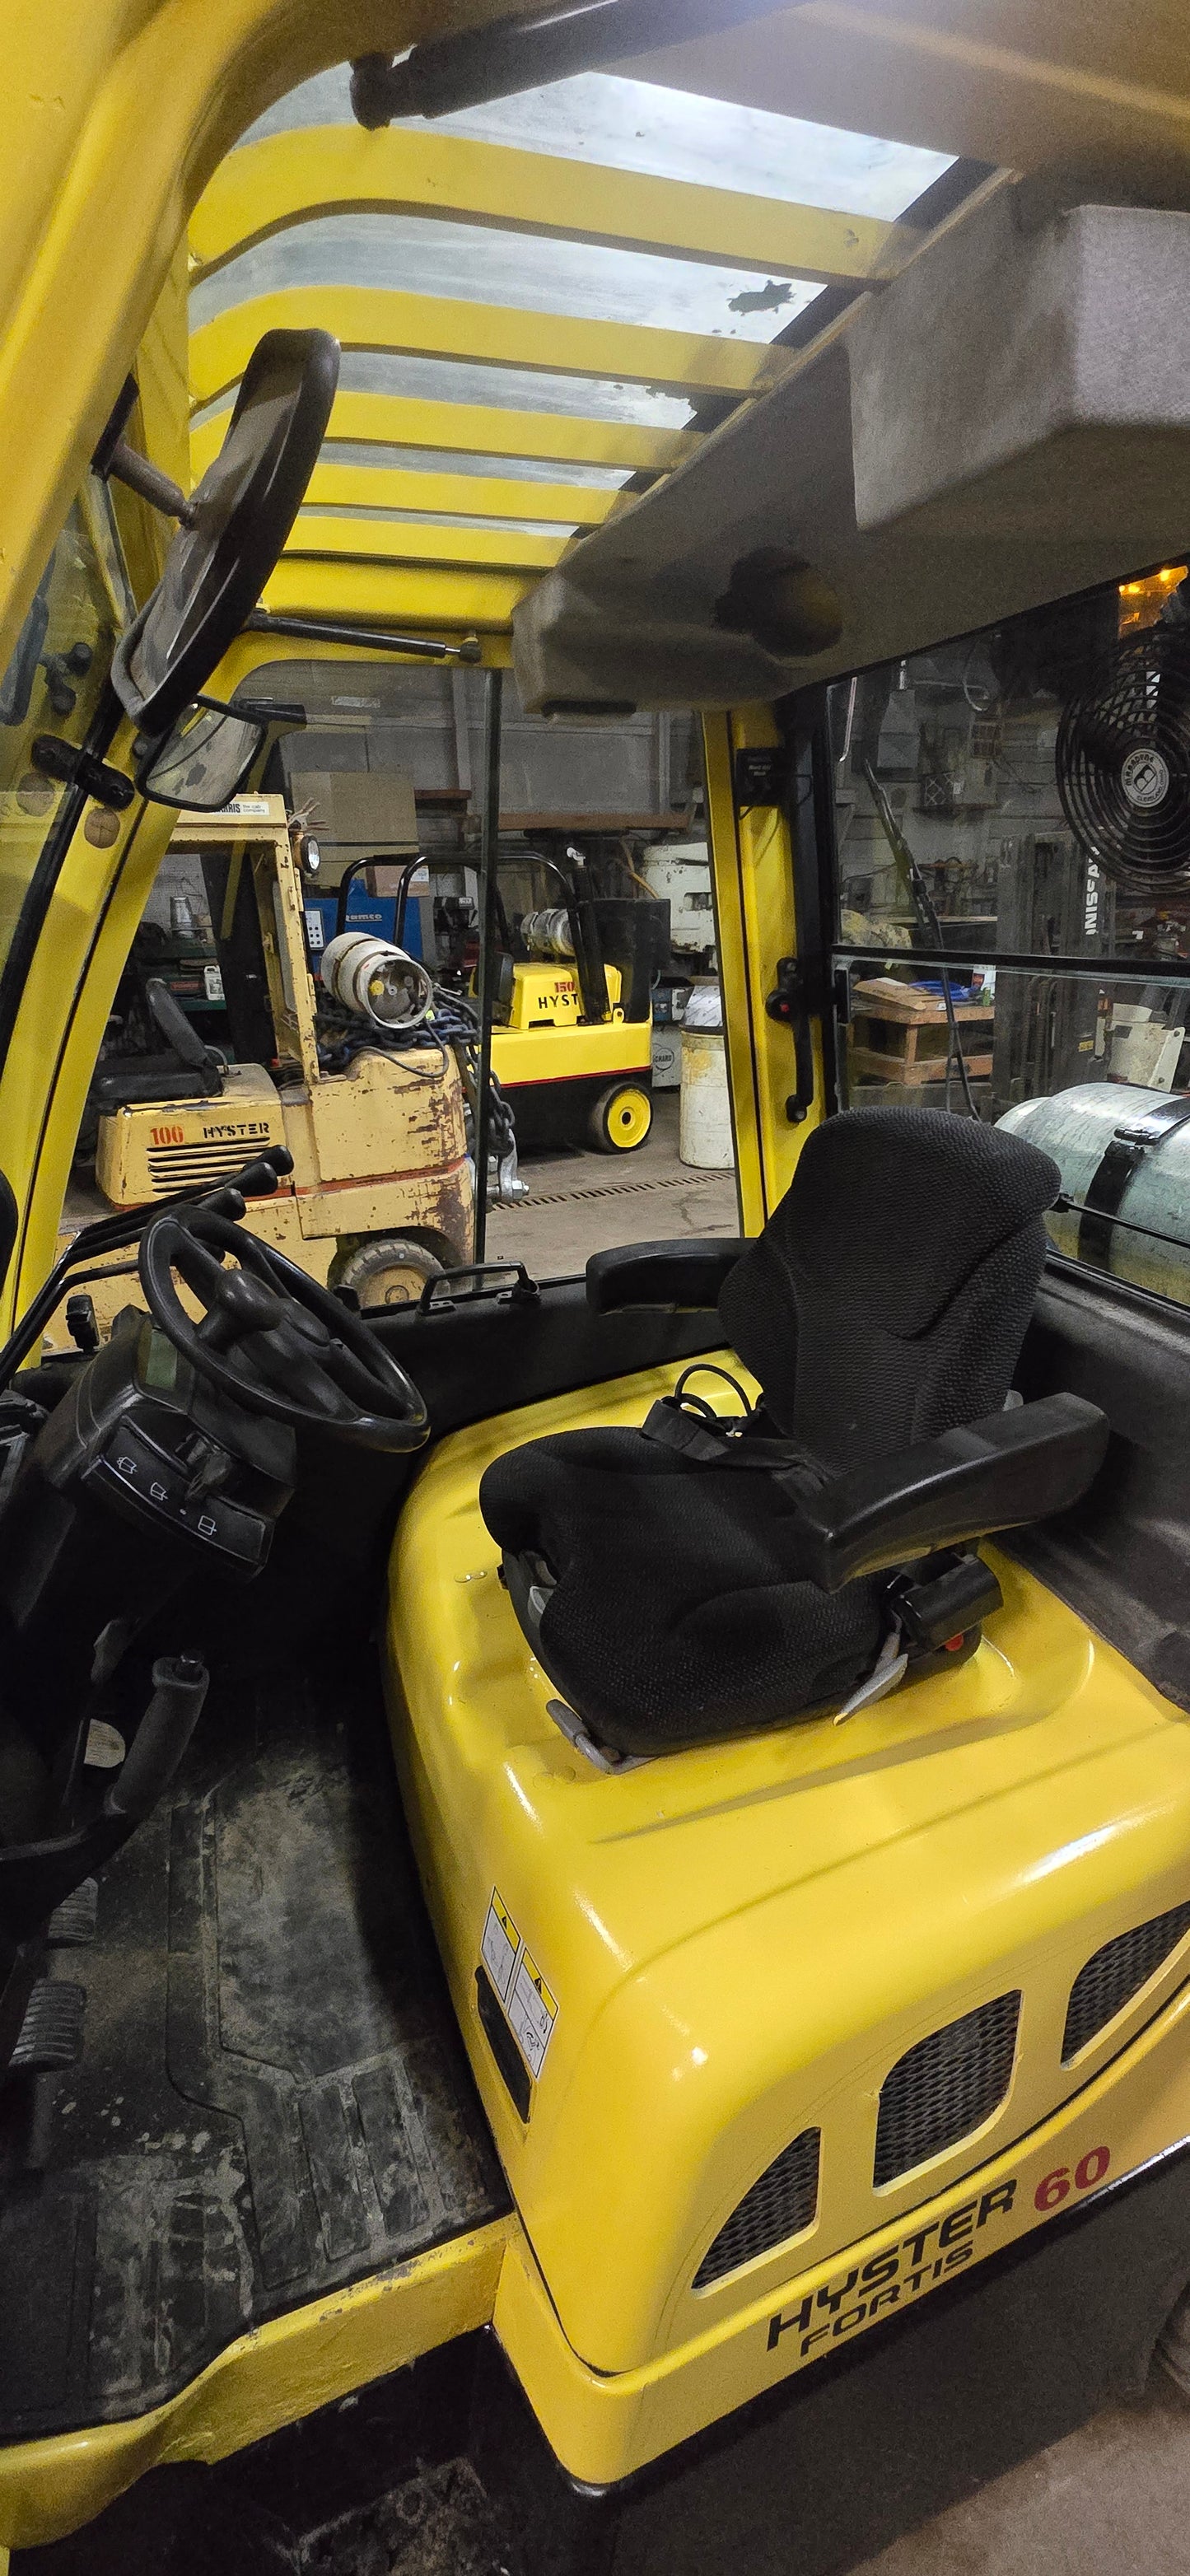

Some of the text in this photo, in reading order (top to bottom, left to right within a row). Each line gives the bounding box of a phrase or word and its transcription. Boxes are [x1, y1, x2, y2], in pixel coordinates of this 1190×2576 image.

[554, 981, 576, 993] 150
[538, 992, 579, 1010] HYST
[150, 1122, 270, 1146] 100 HYSTER
[767, 2145, 1111, 2353] HYSTER 60
[800, 2239, 973, 2358] FORTIS
